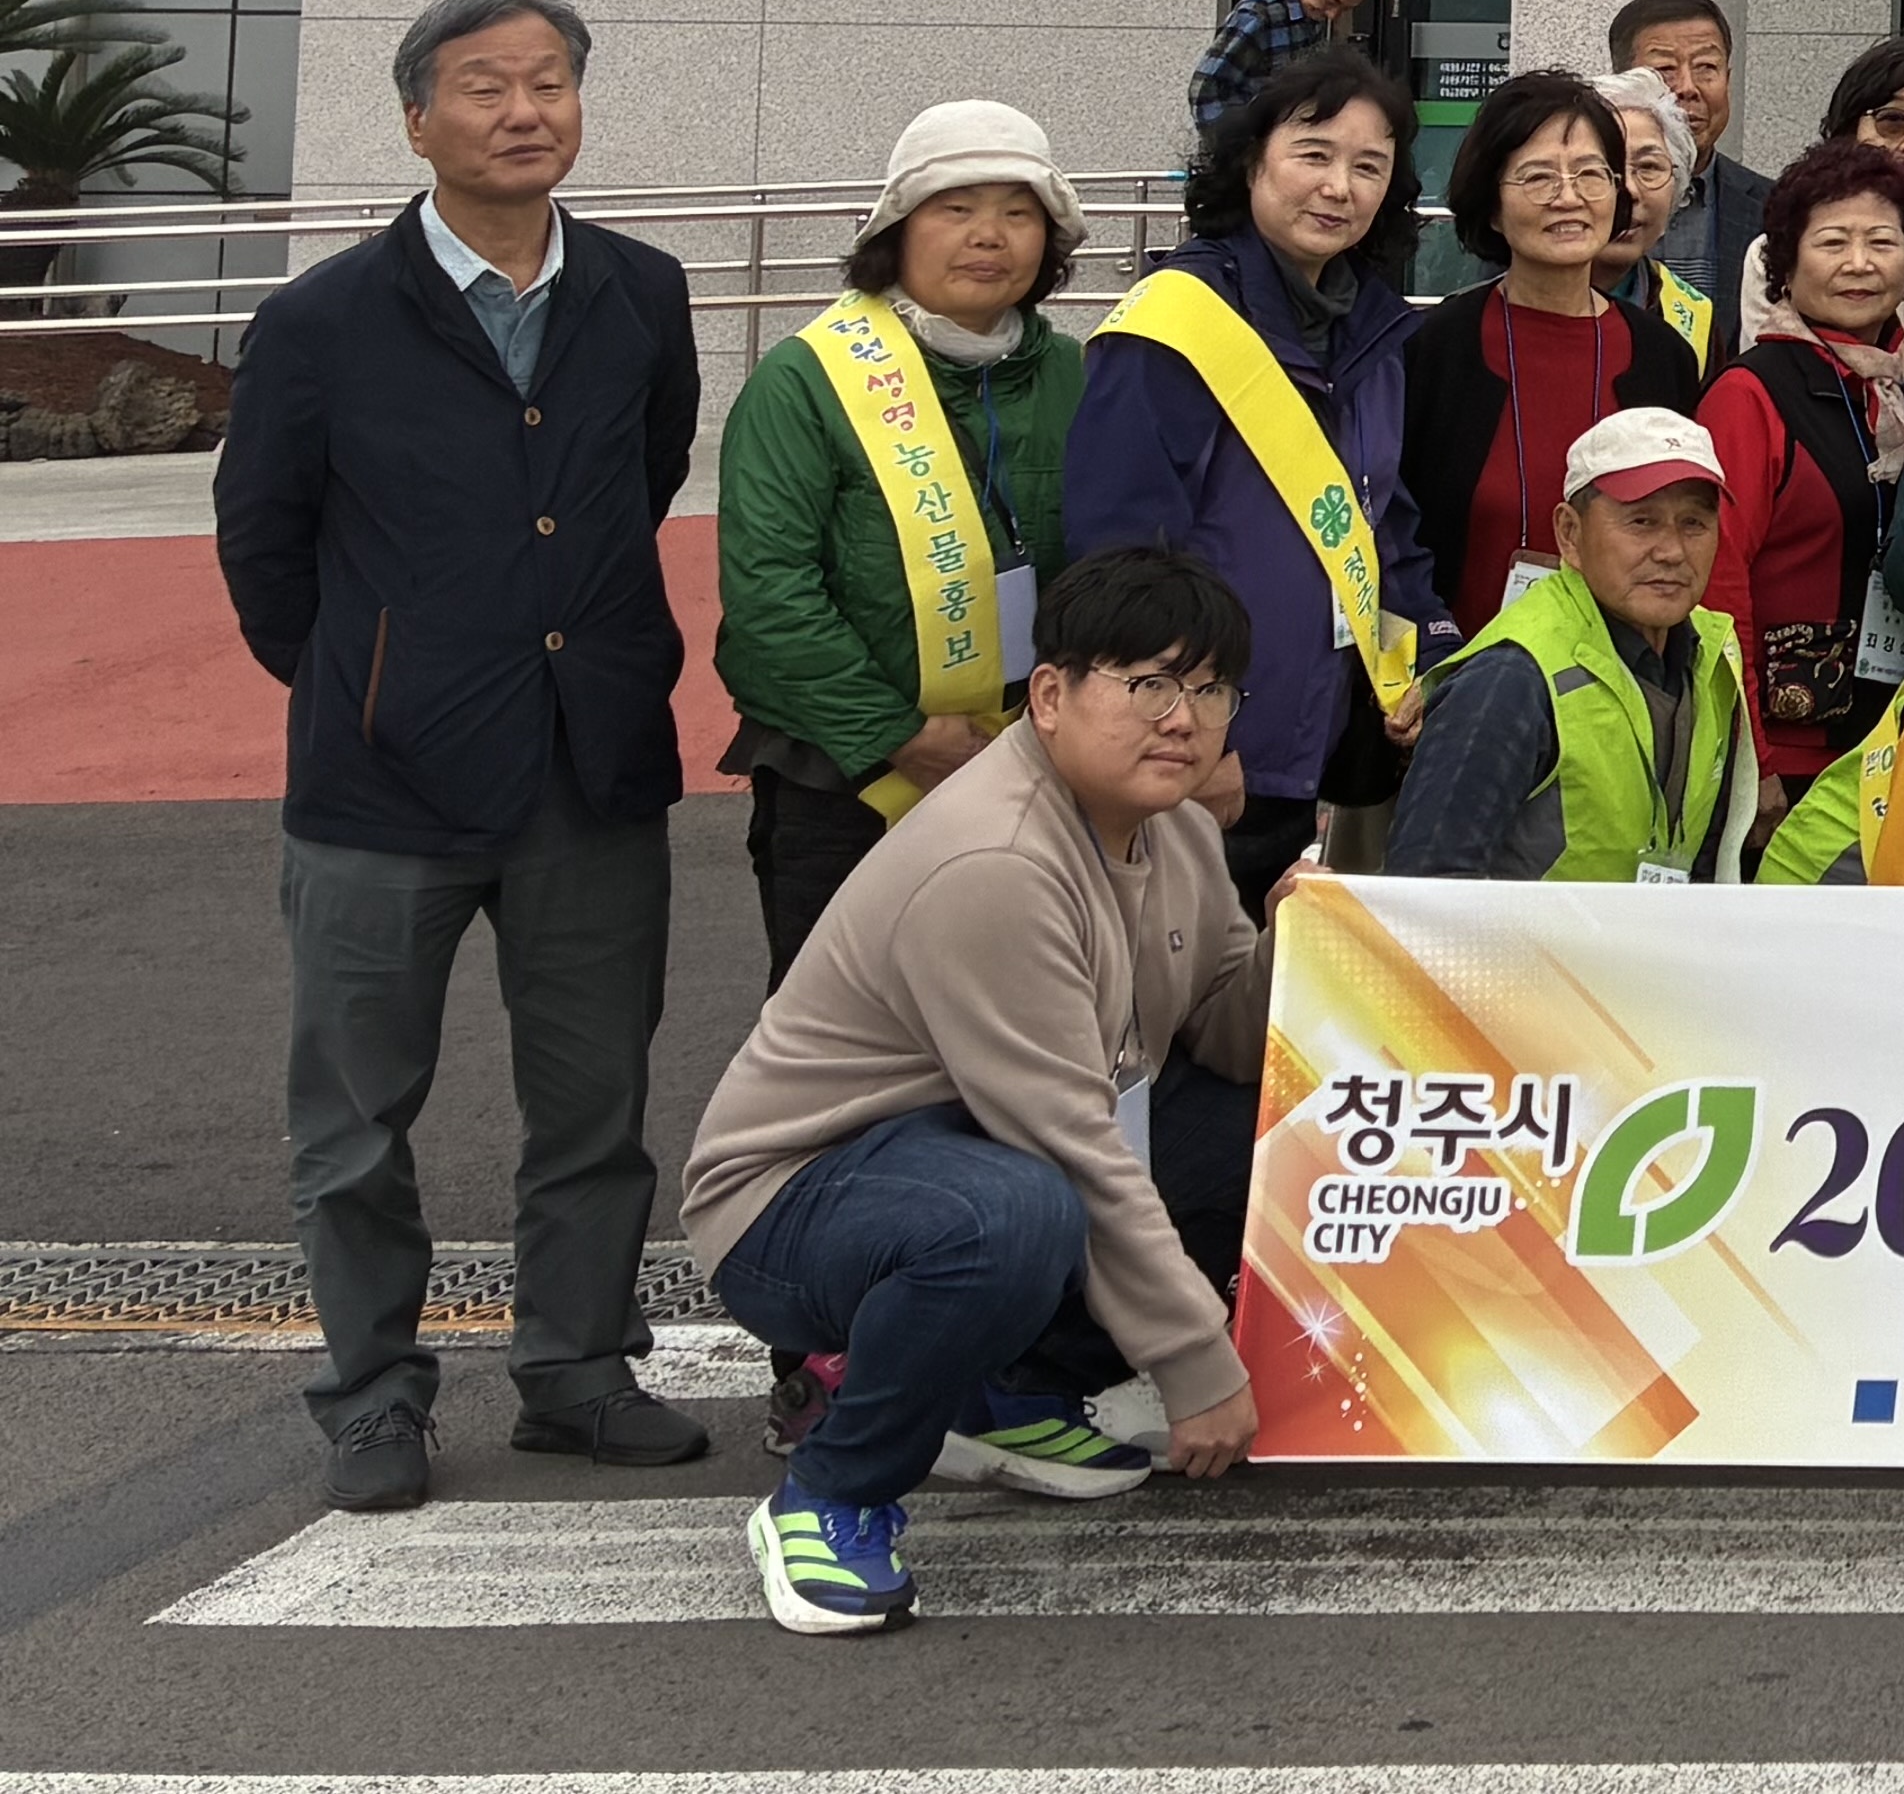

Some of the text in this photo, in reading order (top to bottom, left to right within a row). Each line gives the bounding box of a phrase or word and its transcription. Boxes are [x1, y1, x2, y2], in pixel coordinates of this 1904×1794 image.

[894, 442, 981, 671] 농산물홍보
[1325, 1075, 1573, 1169] 청주시
[1317, 1183, 1503, 1224] CHEONGJU
[1311, 1223, 1392, 1254] CITY
